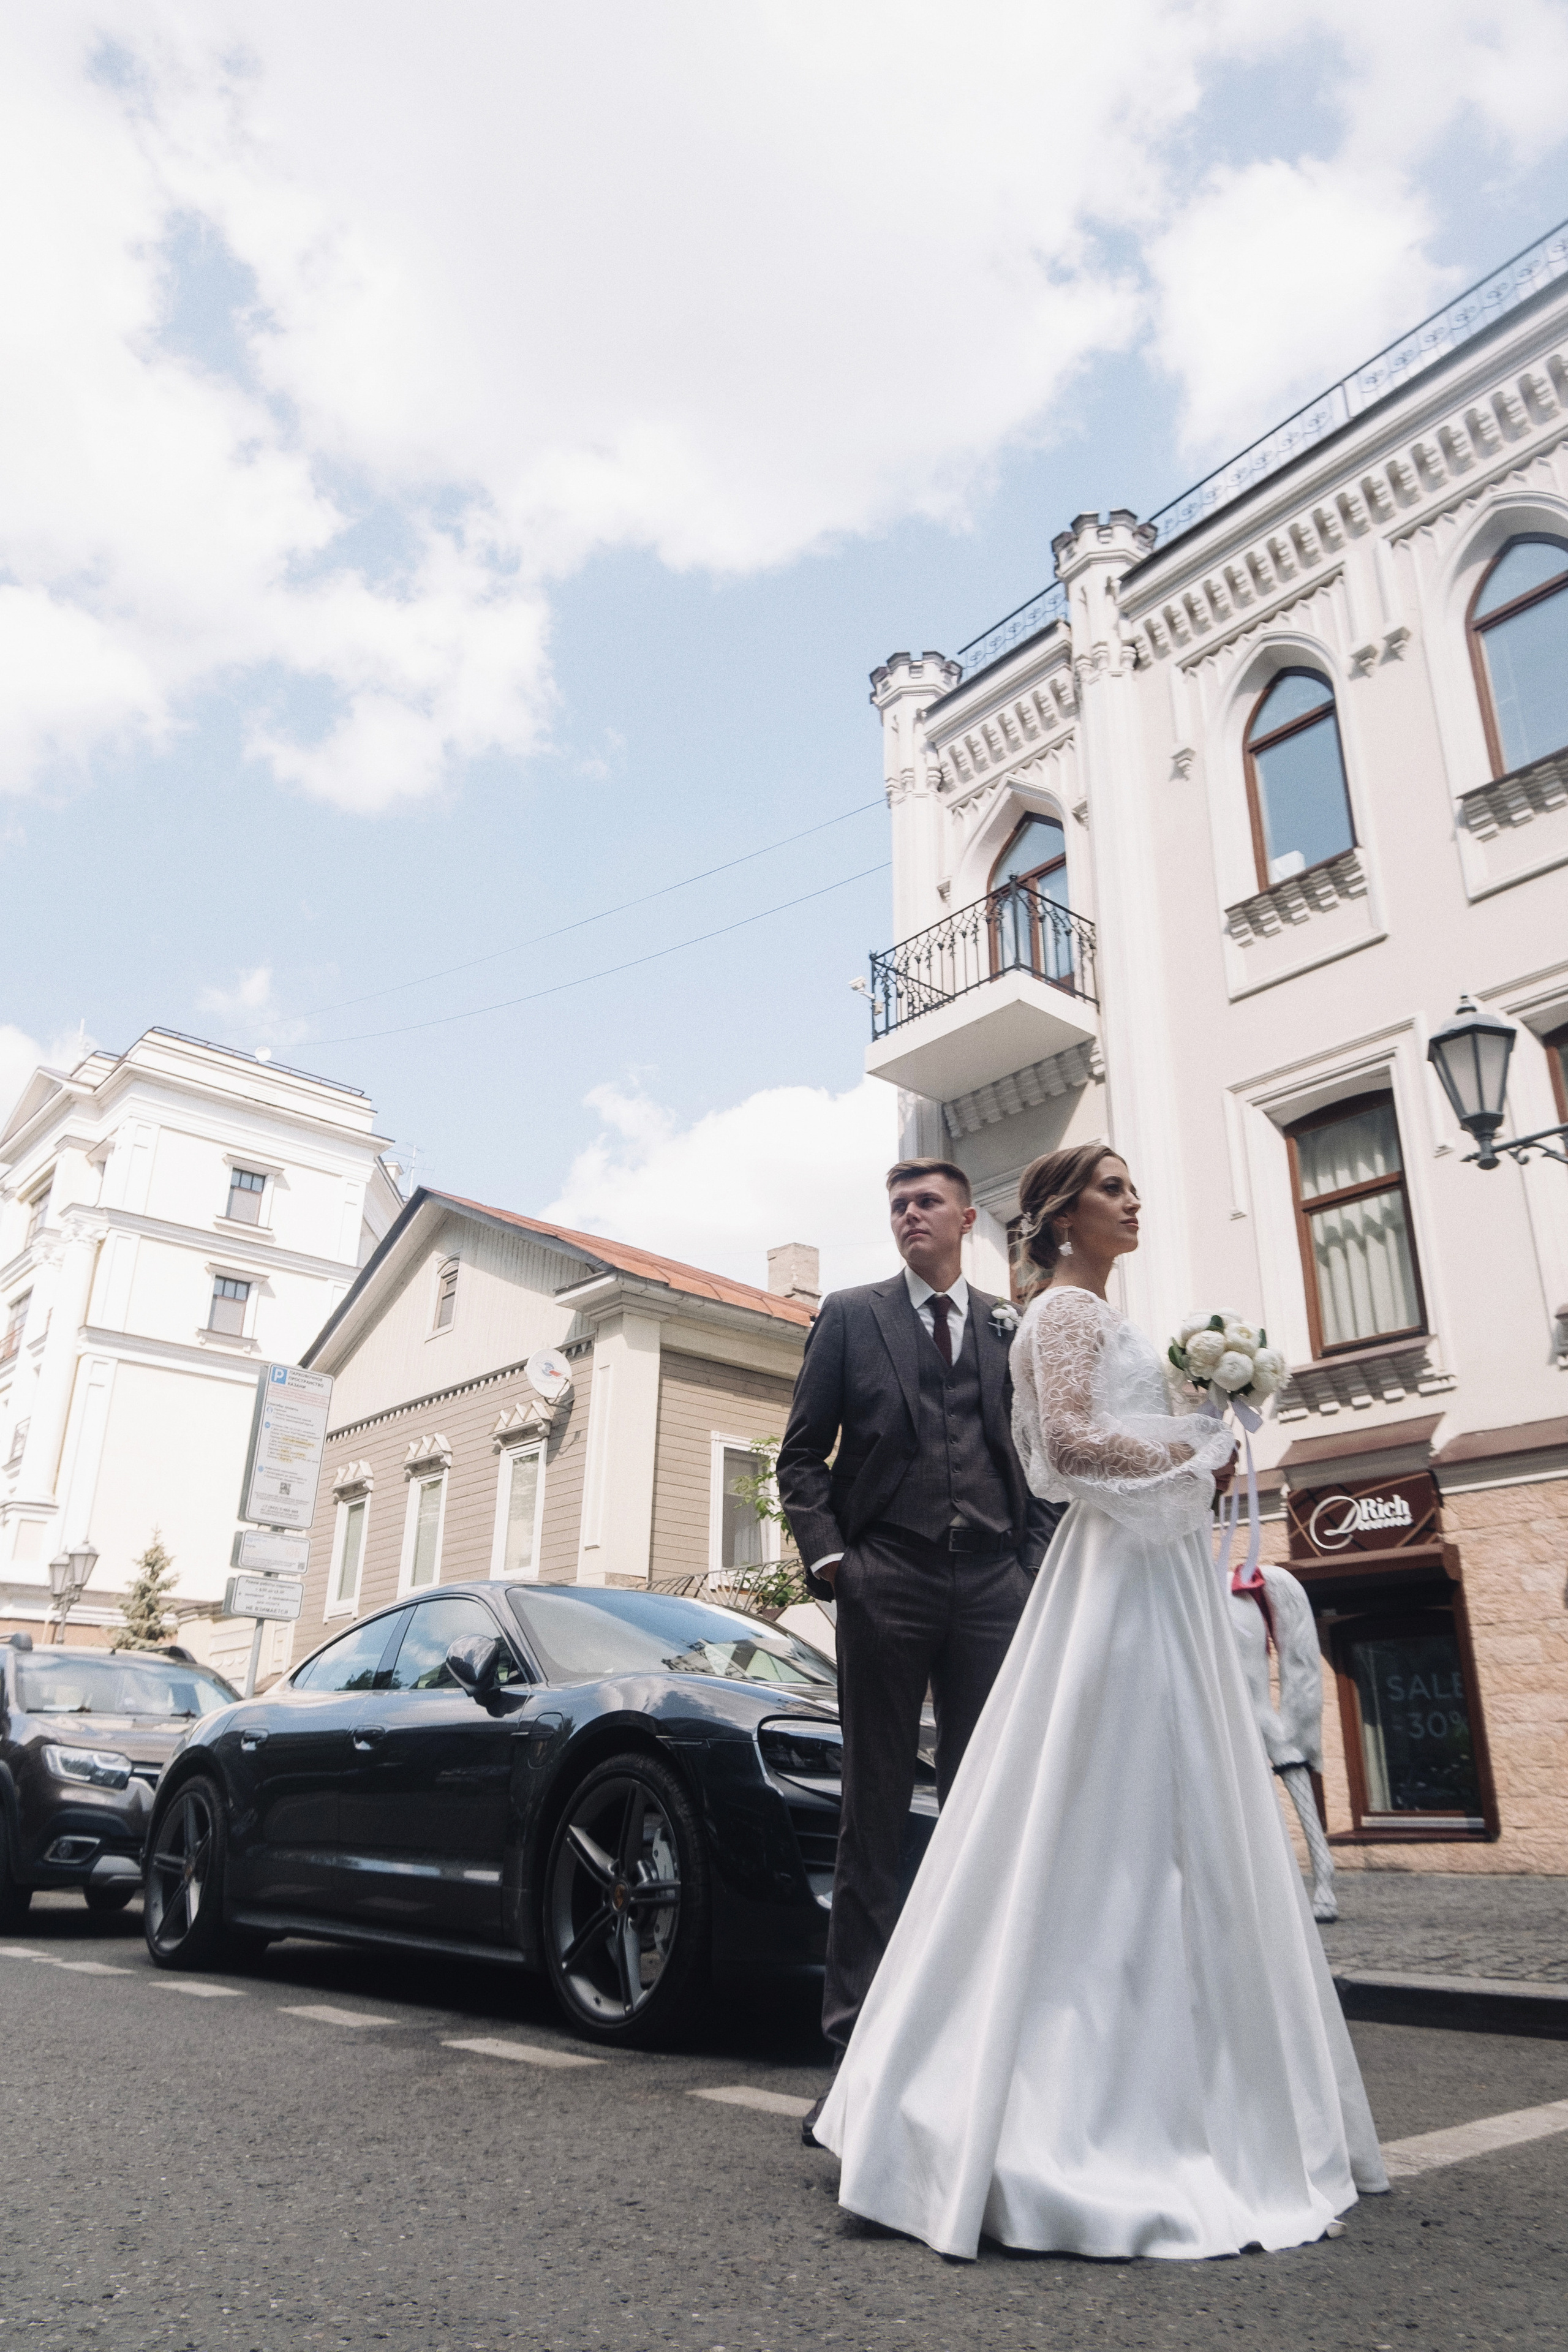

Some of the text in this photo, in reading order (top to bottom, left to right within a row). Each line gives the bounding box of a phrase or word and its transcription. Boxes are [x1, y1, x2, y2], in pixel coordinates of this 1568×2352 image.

[274, 1368, 284, 1381] P
[289, 1370, 323, 1382] ПАРКОВОЧНОЕ
[288, 1376, 324, 1388] ПРОСТРАНСТВО
[1359, 1494, 1412, 1520] Rich
[1386, 1671, 1463, 1702] SALE
